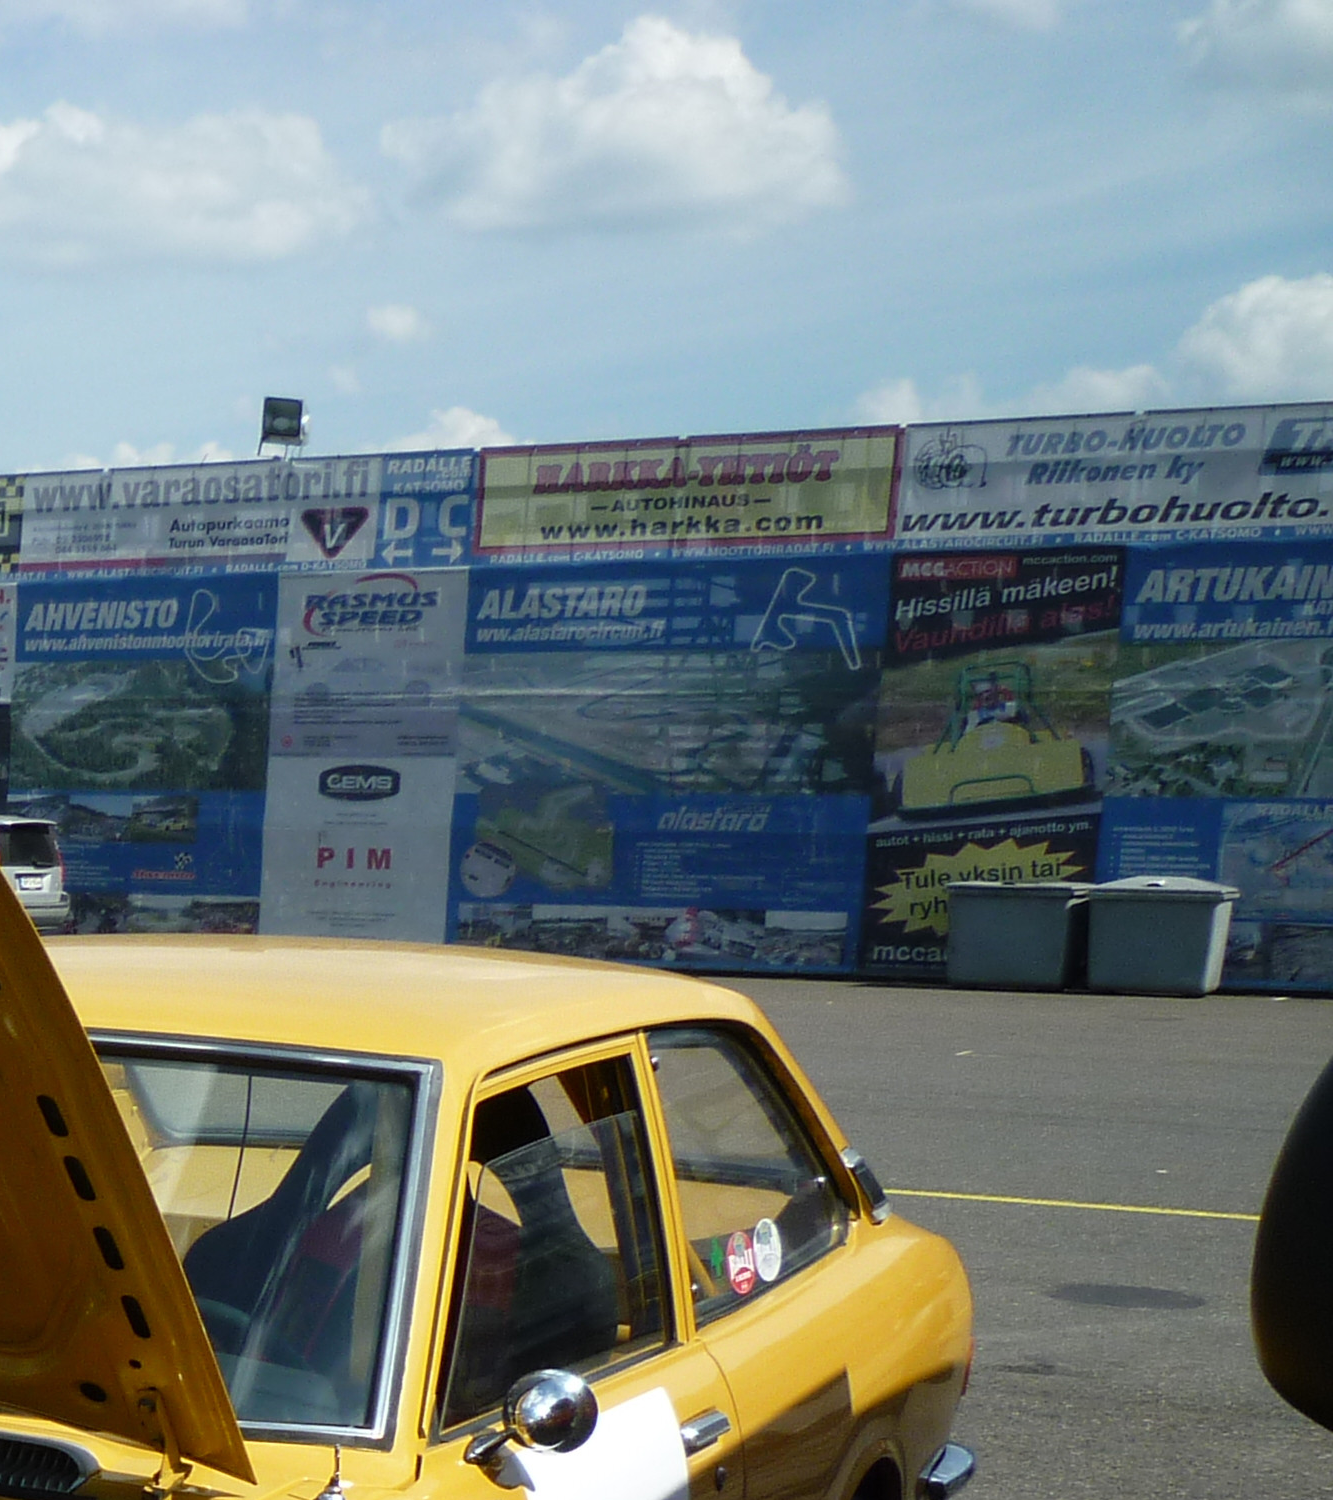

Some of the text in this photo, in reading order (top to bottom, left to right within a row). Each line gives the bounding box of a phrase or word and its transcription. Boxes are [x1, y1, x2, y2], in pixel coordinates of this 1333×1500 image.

[1006, 423, 1246, 456] TURBO-HUOLTO
[387, 456, 473, 474] RADALLE
[533, 445, 840, 494] HARKKA-YHTIÖT
[1025, 455, 1204, 486] Riikonen ky
[33, 461, 369, 513] www.varaosatori.fi
[392, 479, 465, 494] KATSOMO
[169, 516, 290, 536] Autopurkaamo
[384, 495, 470, 539] D C
[901, 492, 1329, 532] www.turbohuolto.
[540, 514, 824, 541] www.harkka.com
[168, 536, 205, 549] Turun
[1022, 554, 1118, 566] mccaction.com
[304, 591, 438, 611] RASMUS
[476, 583, 649, 621] ALASTARO
[895, 565, 1119, 621] Hissillä mäkeen!
[24, 597, 179, 632] AHVENISTO
[319, 609, 424, 627] SPEED
[896, 594, 1116, 653] Vauhdilla alas!
[326, 774, 393, 790] GEMS
[875, 835, 911, 848] autot
[923, 831, 954, 844] hissi
[967, 827, 992, 840] rata
[1010, 822, 1066, 838] ajanotto
[1067, 822, 1093, 834] ym.
[313, 878, 392, 890] Engineering
[901, 870, 952, 890] Tule
[1032, 858, 1063, 879] tai
